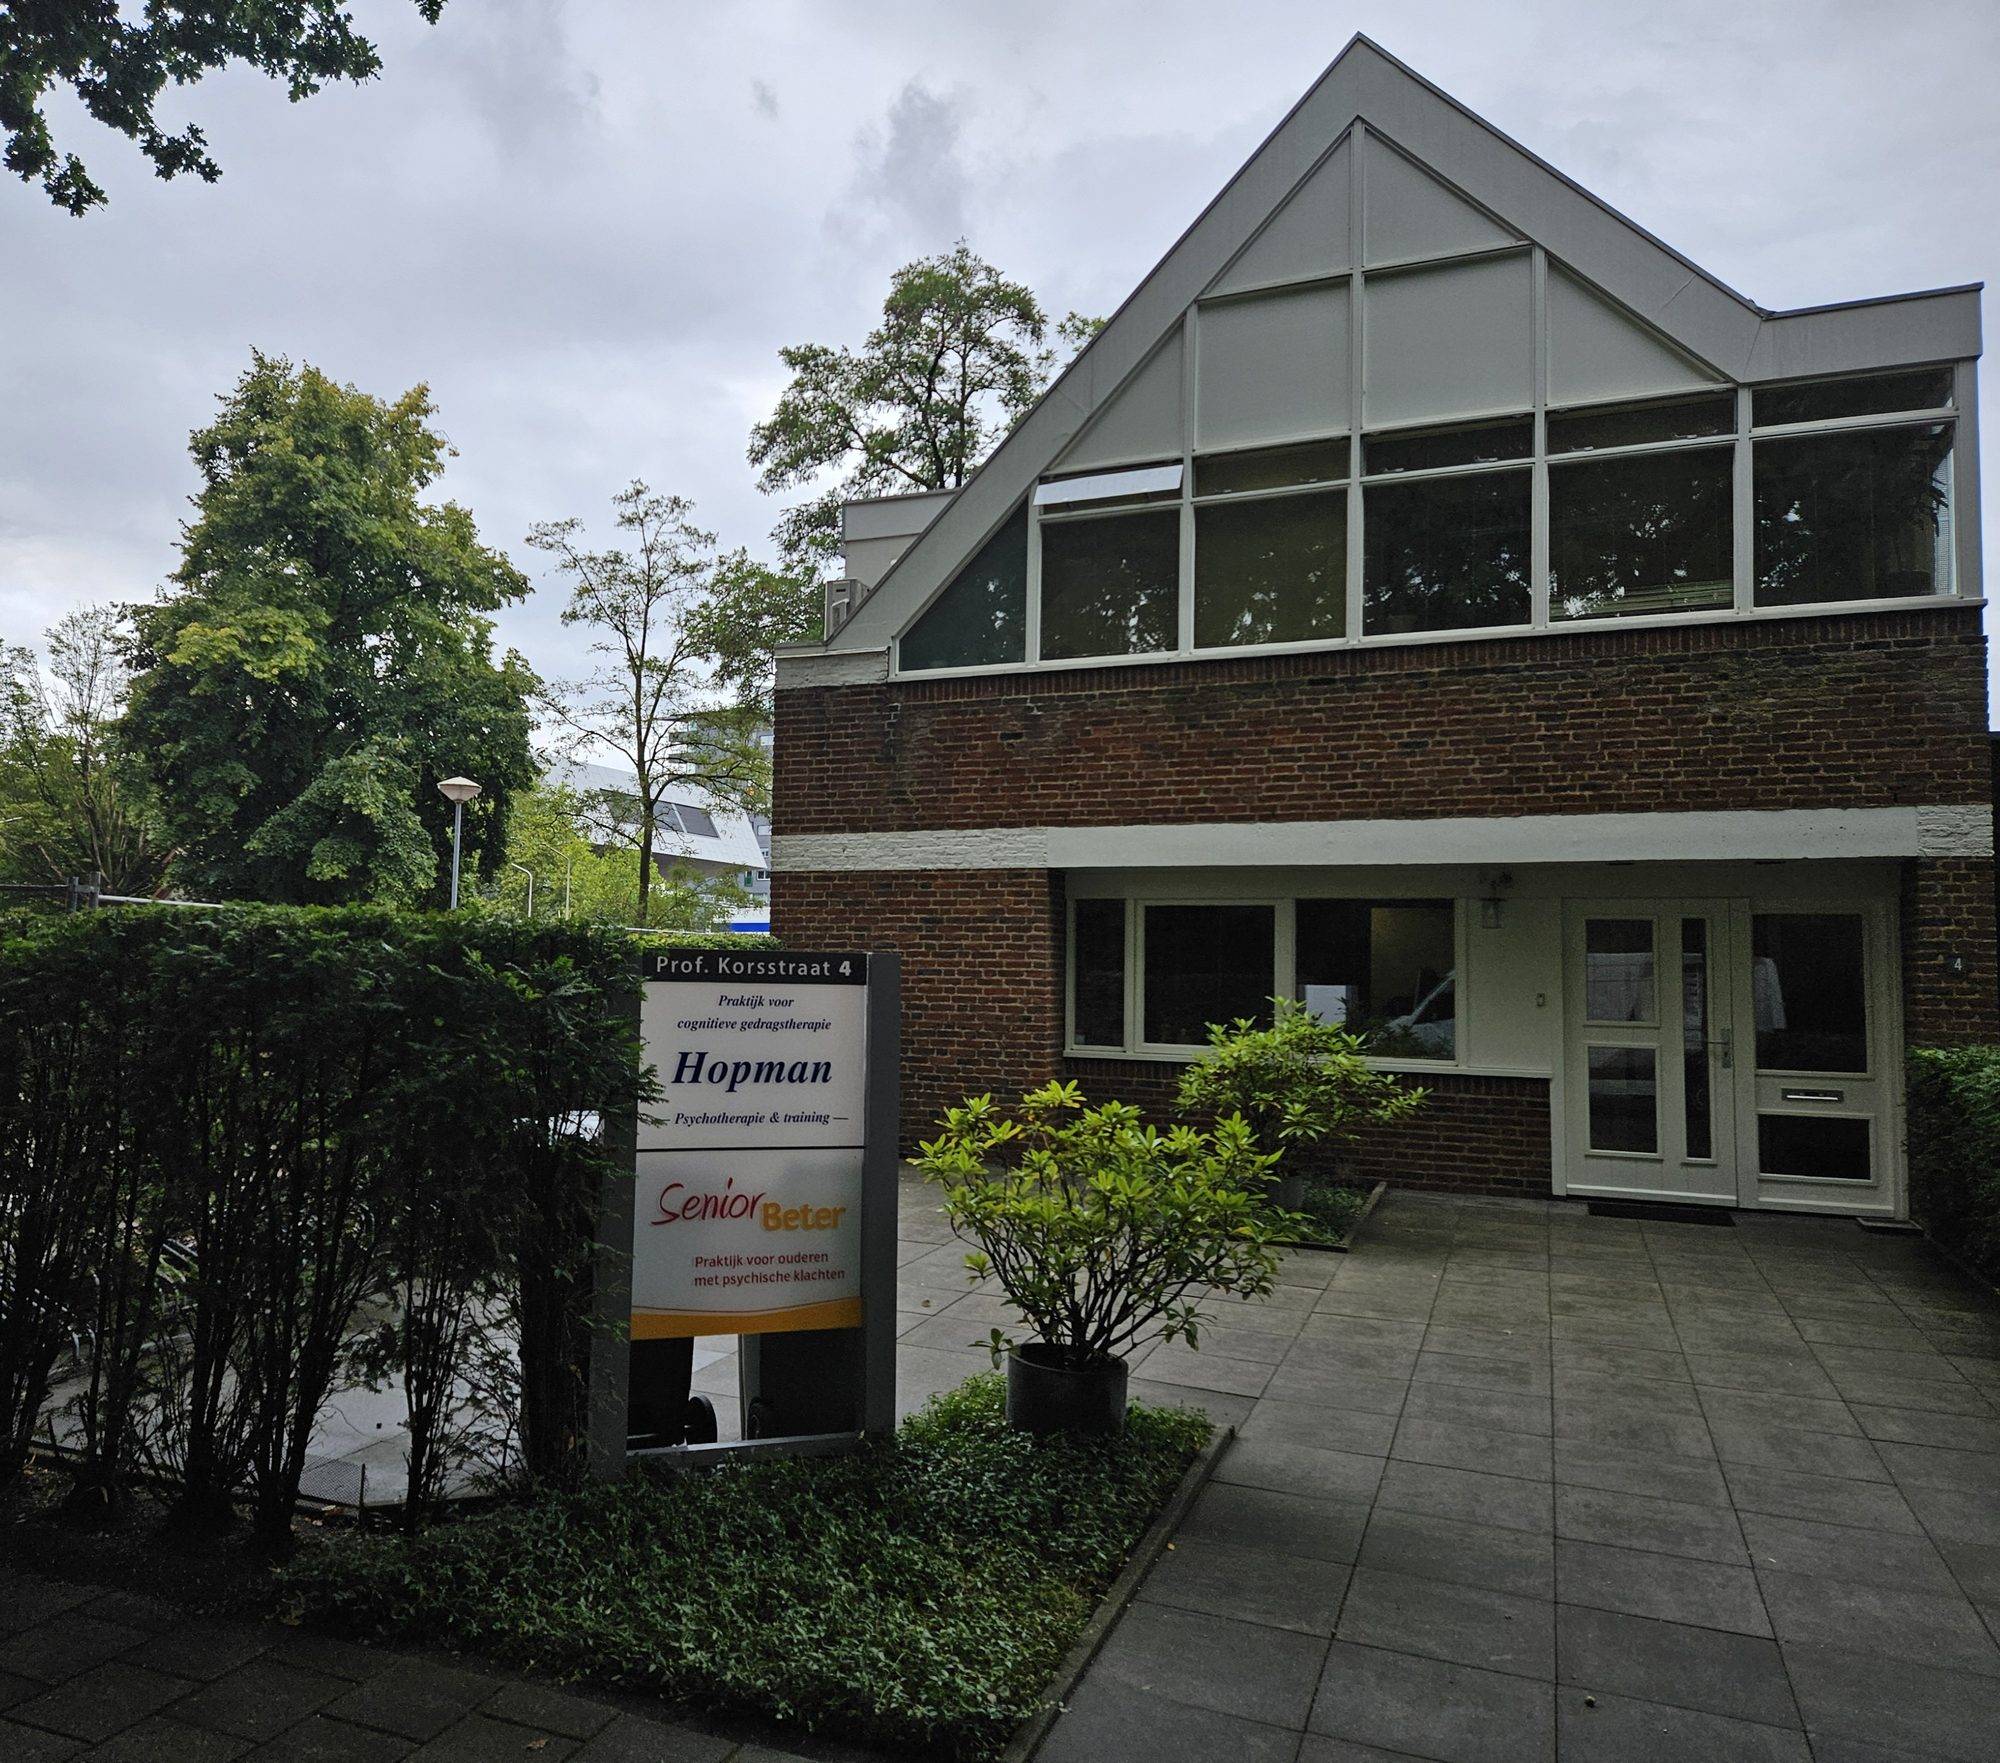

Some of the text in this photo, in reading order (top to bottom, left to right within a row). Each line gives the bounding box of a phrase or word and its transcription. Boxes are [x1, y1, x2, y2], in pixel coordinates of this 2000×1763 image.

[656, 956, 851, 976] Prof. Korsstraat 4
[1954, 957, 1963, 971] 4
[718, 995, 795, 1009] Praktijk voor
[677, 1018, 832, 1033] cognitieve gedragstherapie
[671, 1051, 833, 1093] Hopman
[674, 1112, 830, 1127] Psychotherapie & training
[695, 1251, 828, 1269] Praktijk voor ouderen
[694, 1268, 845, 1288] met psychische klachten
